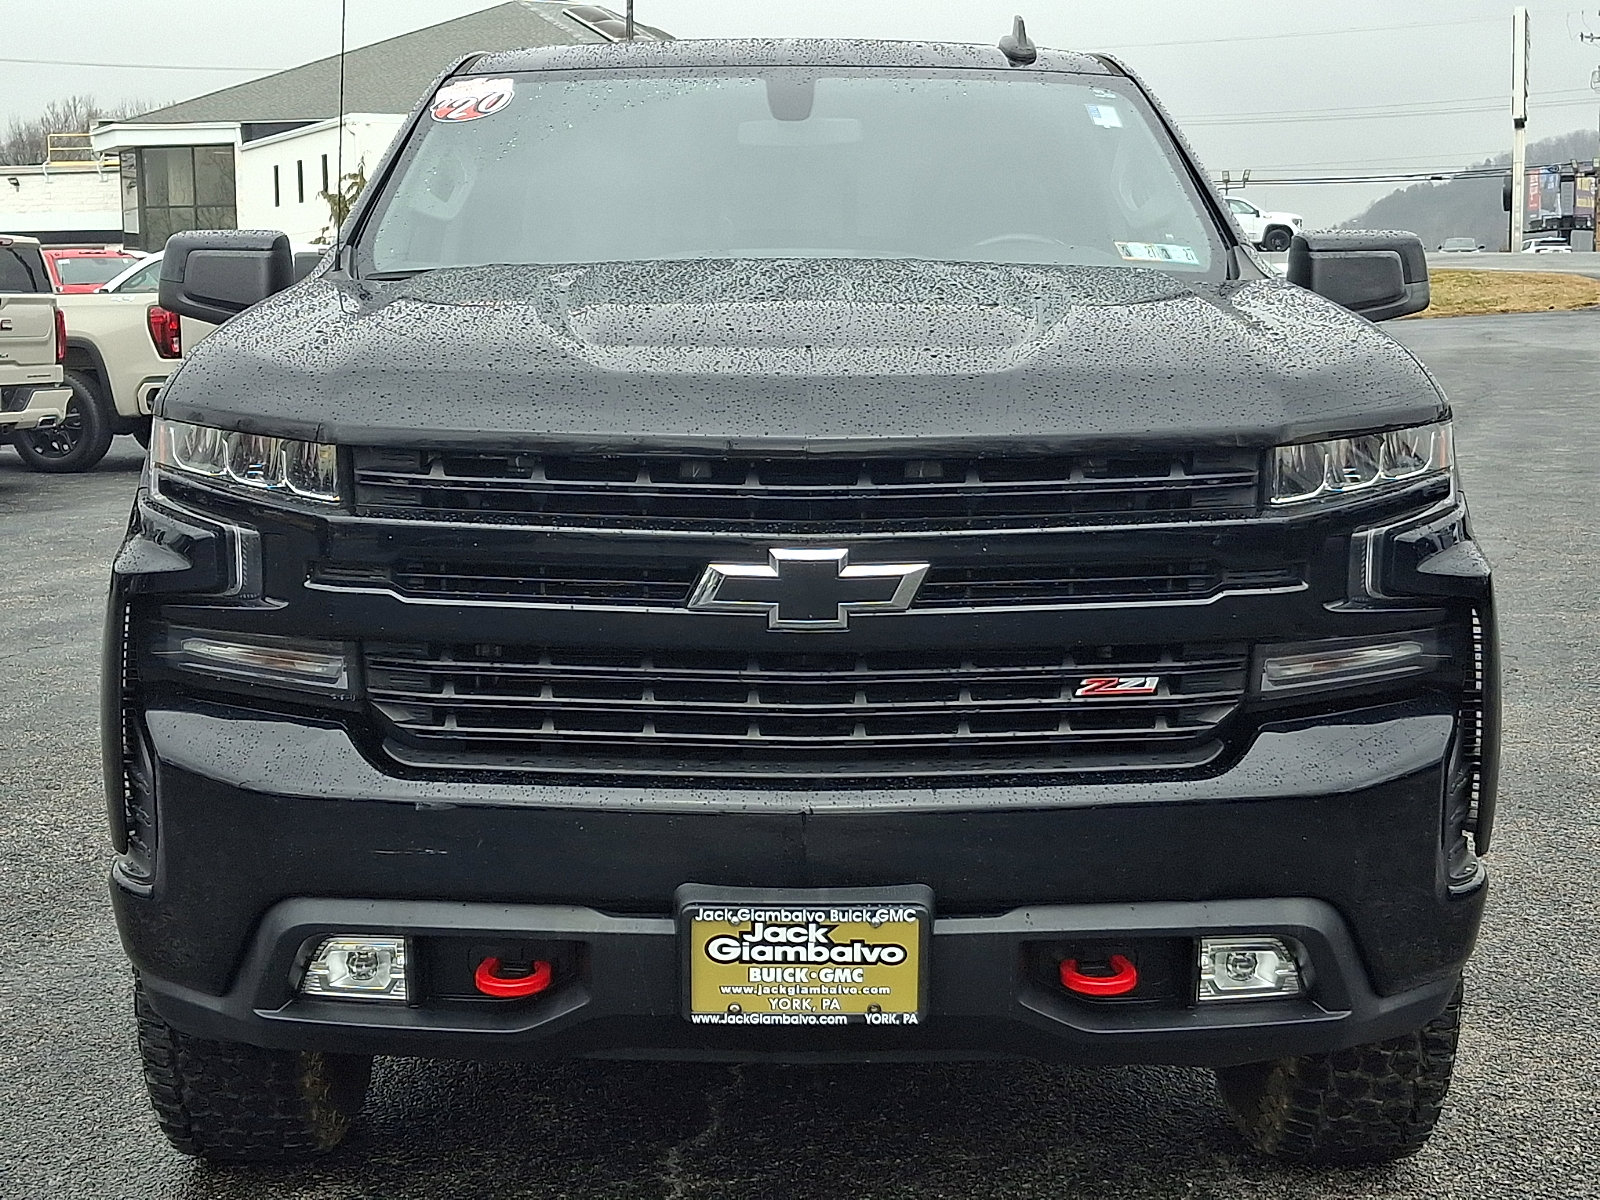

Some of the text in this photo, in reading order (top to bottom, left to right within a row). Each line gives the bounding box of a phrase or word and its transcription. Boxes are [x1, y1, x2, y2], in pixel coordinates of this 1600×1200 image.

[695, 908, 917, 922] Jack Giambalvo Buick GMC
[742, 923, 828, 943] Jack
[708, 937, 904, 962] Giambalvo
[720, 985, 891, 995] www.jackgiambalvo.com
[769, 998, 841, 1012] YORK, PA
[691, 1014, 848, 1025] www.JackGiambalvo.com
[902, 1014, 918, 1025] PA
